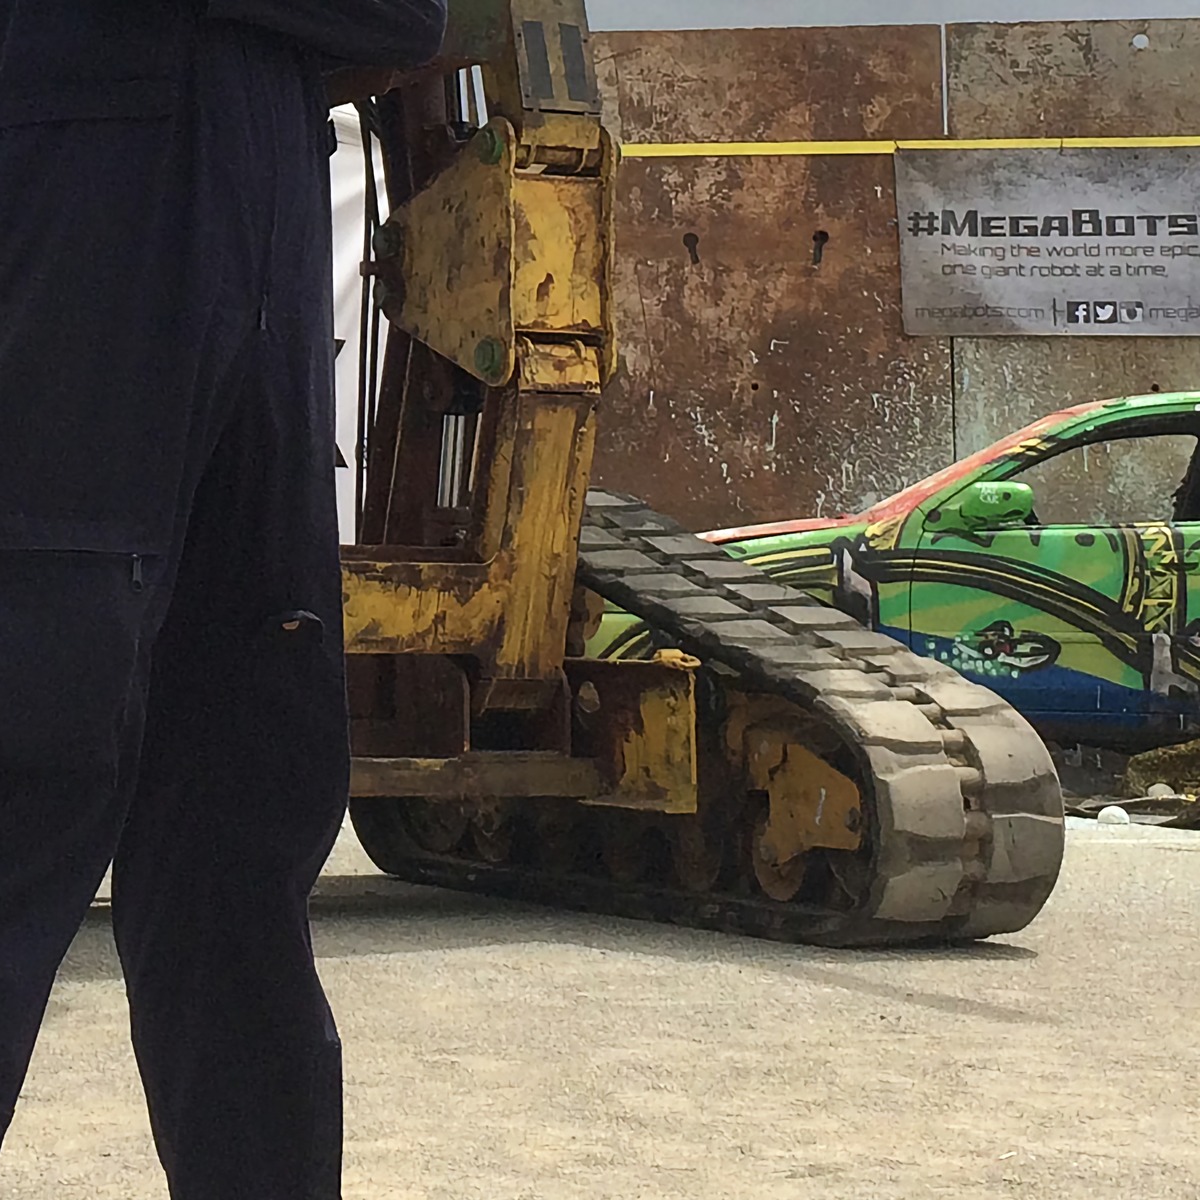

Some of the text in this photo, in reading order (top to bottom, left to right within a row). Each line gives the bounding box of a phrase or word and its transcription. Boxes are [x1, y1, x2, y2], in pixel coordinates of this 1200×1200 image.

[907, 209, 1198, 237] #MEGABOTS
[941, 243, 1006, 261] Making
[1010, 244, 1041, 257] the
[1046, 243, 1100, 257] world
[1105, 246, 1155, 257] more
[941, 263, 977, 276] one
[981, 264, 1026, 279] giant
[1030, 263, 1081, 277] robot
[1085, 263, 1105, 277] at
[1109, 265, 1121, 277] a
